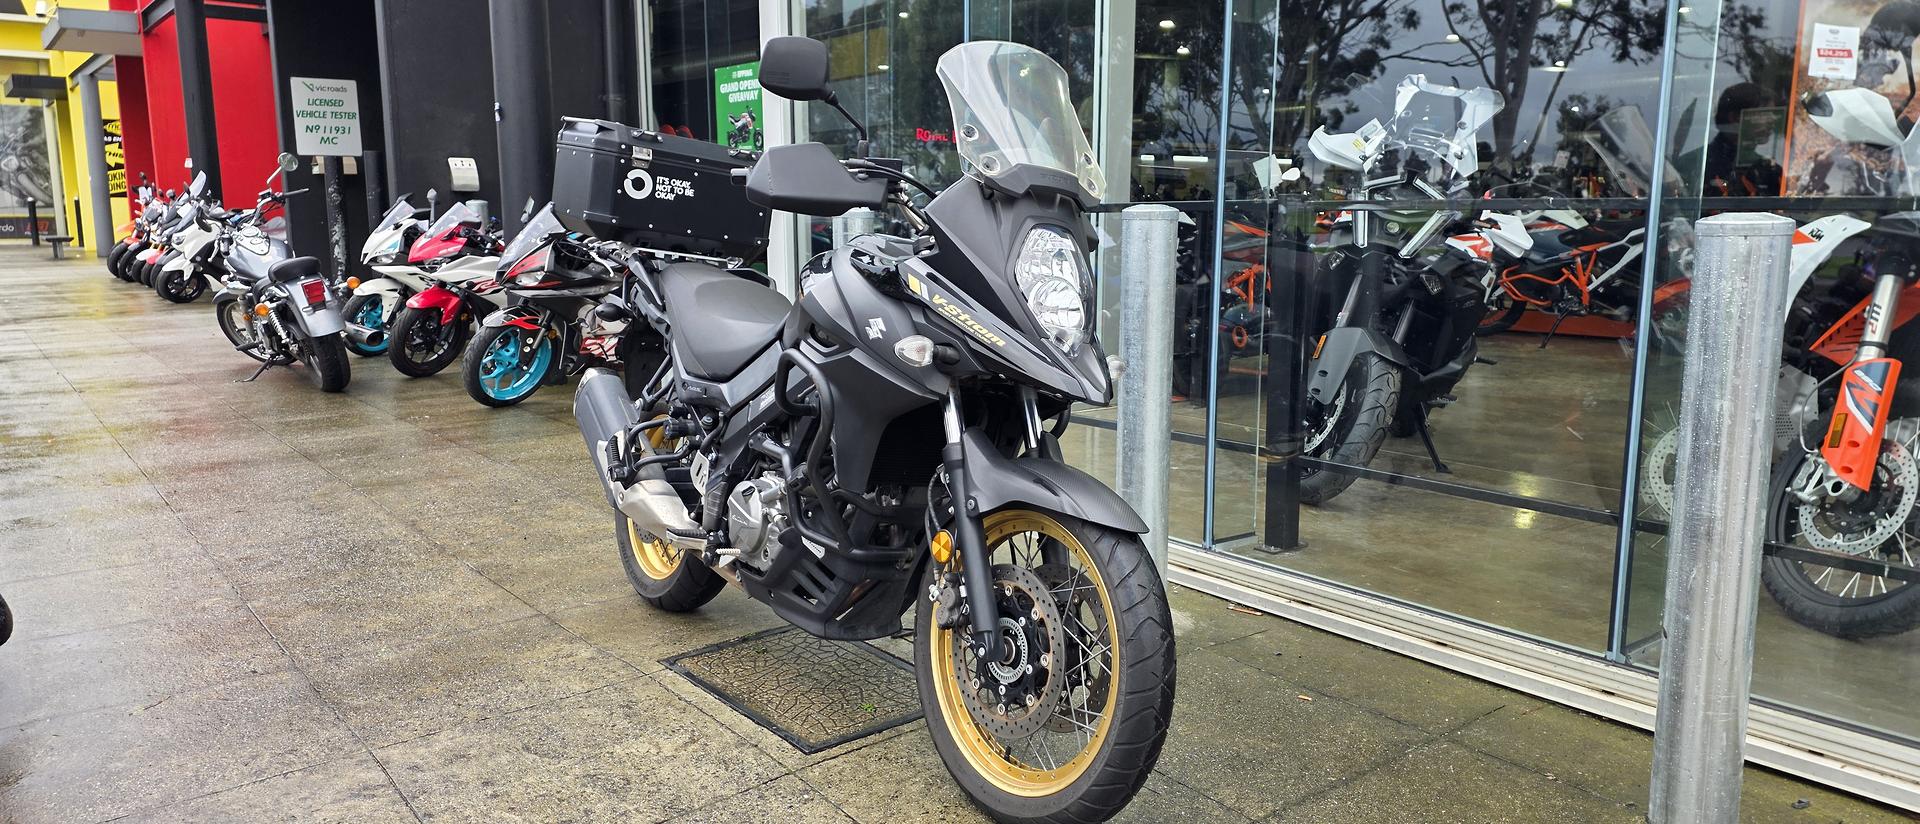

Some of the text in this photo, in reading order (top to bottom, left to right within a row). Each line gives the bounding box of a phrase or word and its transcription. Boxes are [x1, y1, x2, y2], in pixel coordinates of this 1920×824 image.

[720, 81, 739, 94] GRAND
[729, 90, 759, 103] GIVEAWAY
[307, 98, 345, 107] LICENSED
[296, 110, 357, 120] VEHICLE TESTER
[323, 125, 351, 135] 11931
[319, 136, 338, 145] MC
[656, 176, 669, 185] IT'S
[655, 184, 672, 192] NOT
[685, 189, 695, 197] BE
[655, 191, 676, 200] OKAY
[1808, 228, 1825, 242] KTM
